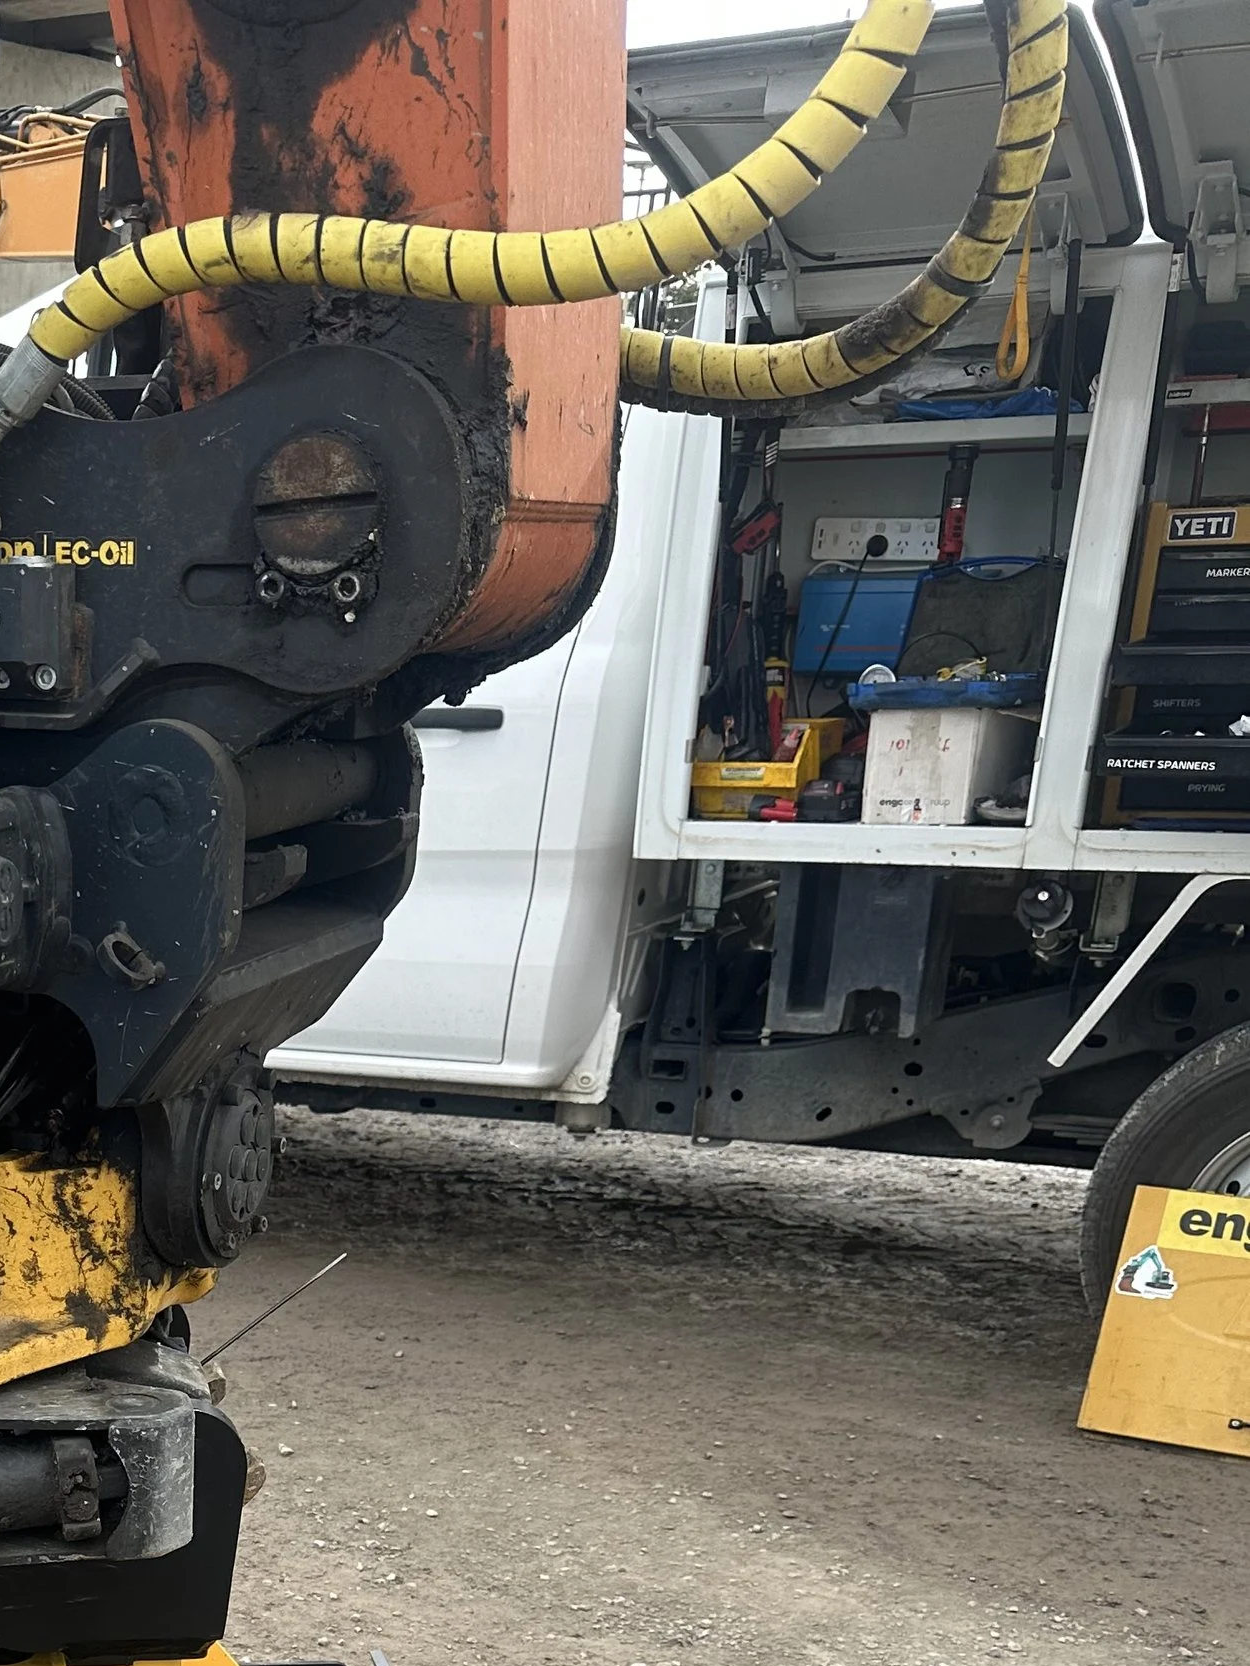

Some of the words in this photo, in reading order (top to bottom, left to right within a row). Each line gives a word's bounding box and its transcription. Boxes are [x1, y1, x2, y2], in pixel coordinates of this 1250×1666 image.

[1174, 516, 1231, 536] YETI
[55, 540, 134, 566] EC-Oil
[1152, 698, 1202, 708] SHIFTERS
[1106, 758, 1156, 769] RATCHET
[1156, 760, 1216, 771] SPANNERS
[1187, 783, 1226, 793] PRYING
